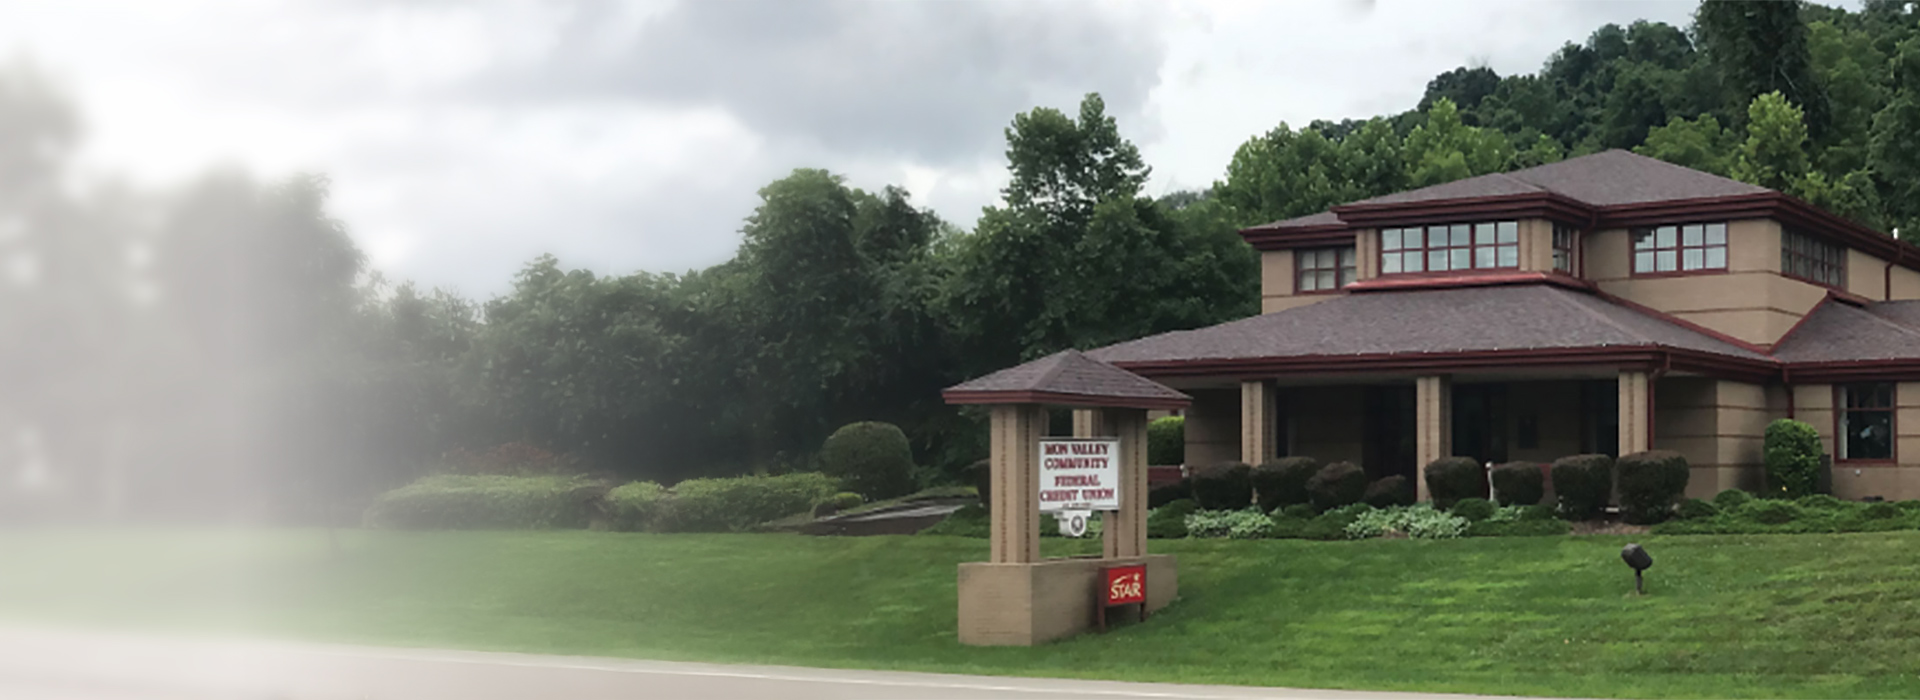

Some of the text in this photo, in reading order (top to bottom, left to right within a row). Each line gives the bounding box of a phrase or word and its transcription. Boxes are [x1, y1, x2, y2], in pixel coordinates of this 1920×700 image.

[1044, 443, 1109, 455] MON VALLEY
[1044, 457, 1109, 470] COMMUNITY
[1054, 475, 1101, 487] FEDERAL
[1040, 488, 1114, 502] CREDIT UNION
[1110, 582, 1142, 600] STAR
